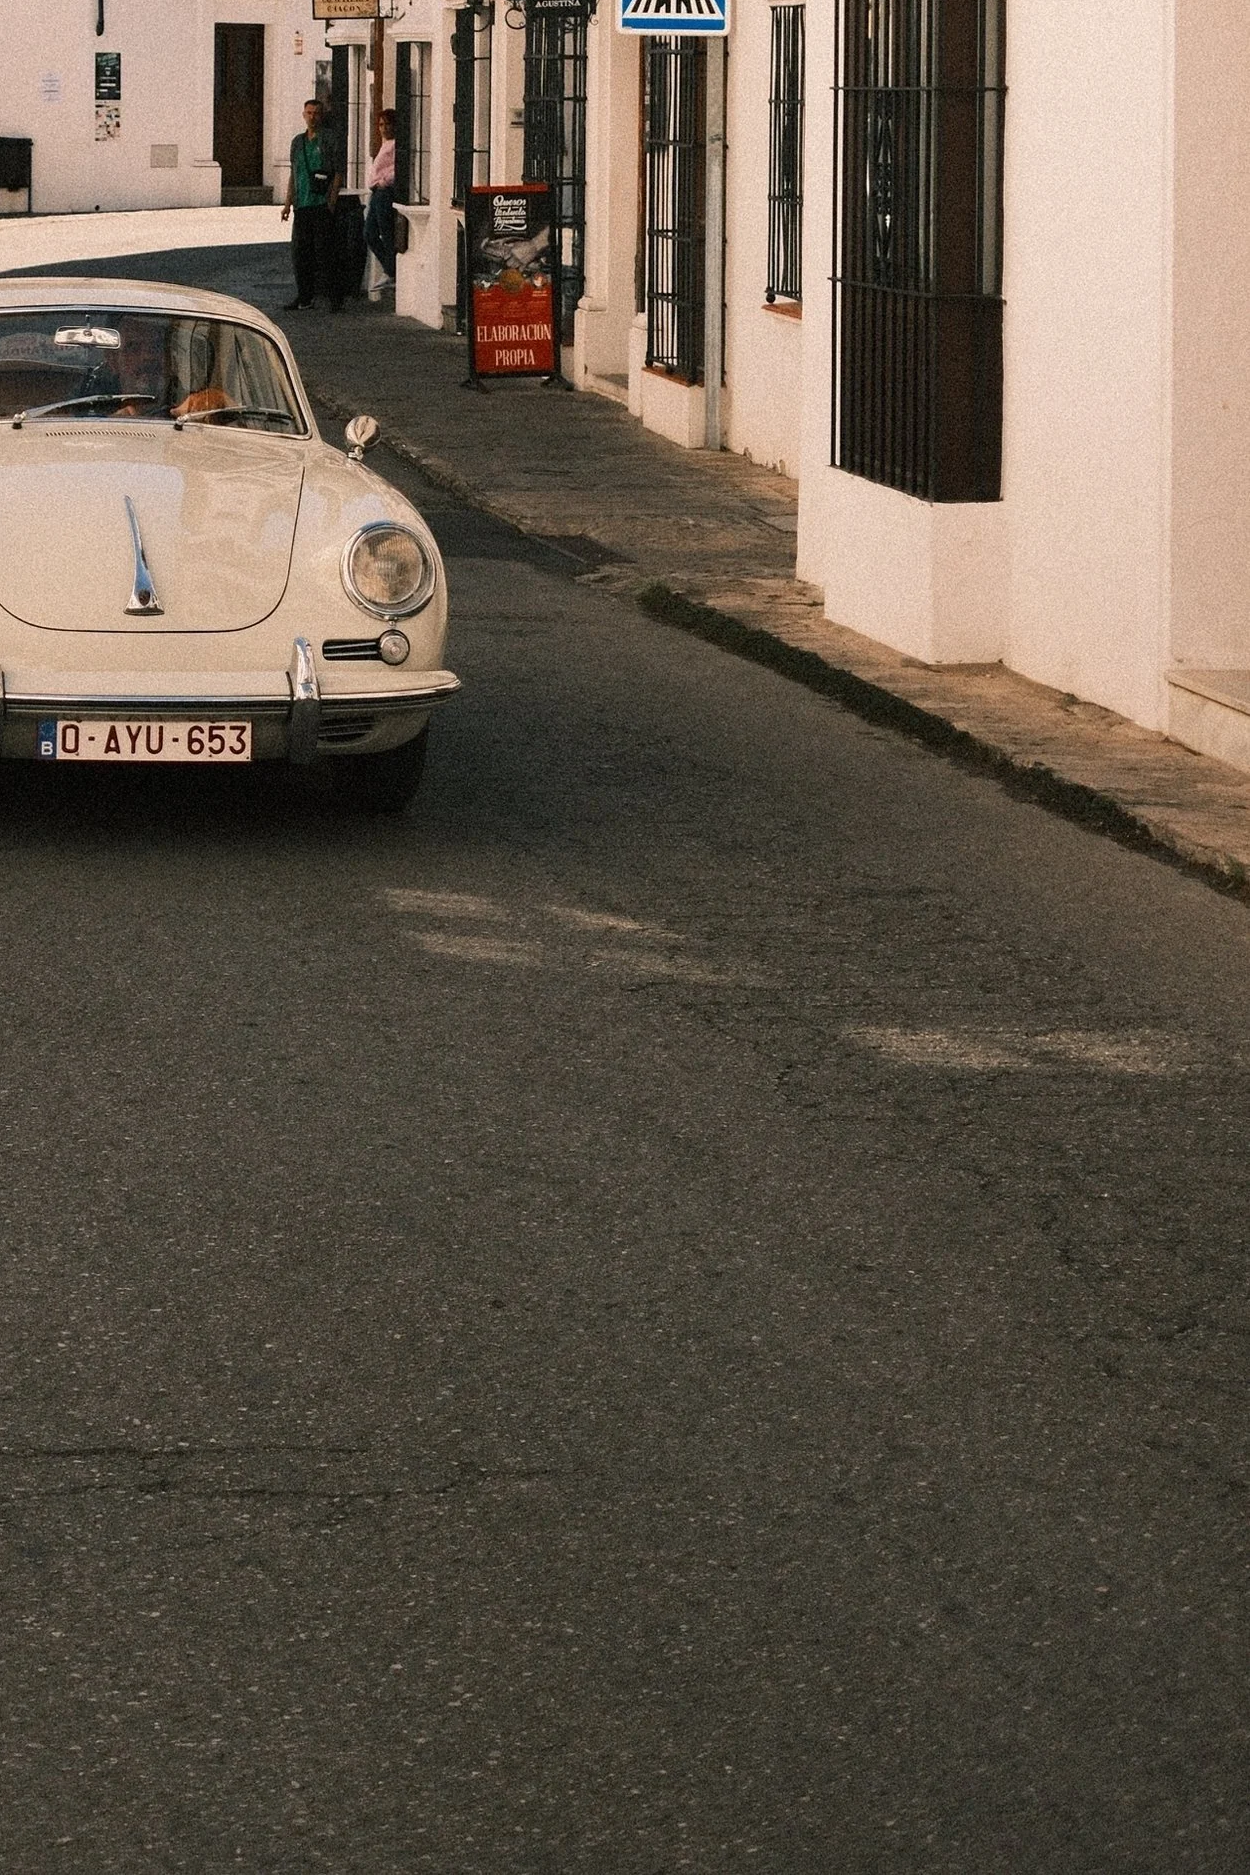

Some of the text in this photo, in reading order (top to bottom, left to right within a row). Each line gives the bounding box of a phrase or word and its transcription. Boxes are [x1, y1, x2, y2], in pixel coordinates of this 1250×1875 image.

[535, 0, 581, 8] AGUSTINA
[493, 194, 527, 207] Quesos
[477, 321, 551, 342] ELABORACIÓN
[495, 349, 535, 366] PROPIA
[41, 740, 54, 755] B
